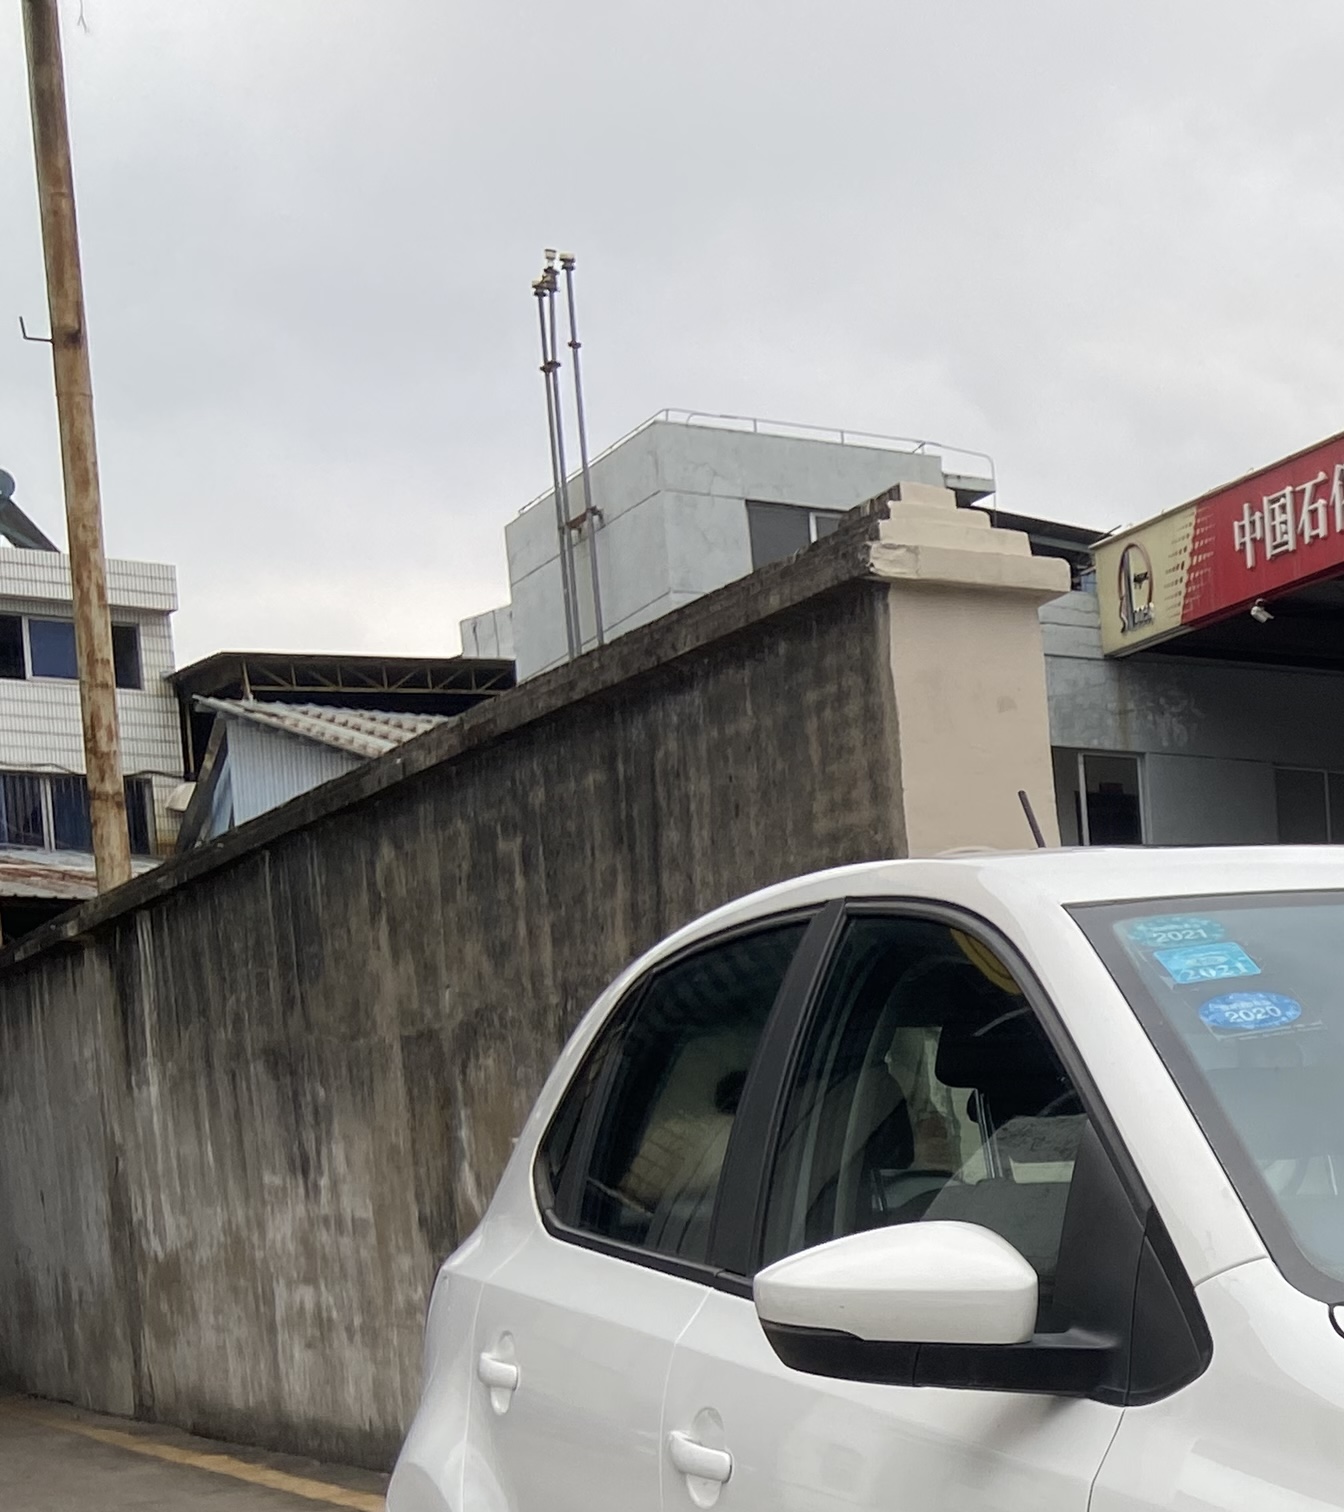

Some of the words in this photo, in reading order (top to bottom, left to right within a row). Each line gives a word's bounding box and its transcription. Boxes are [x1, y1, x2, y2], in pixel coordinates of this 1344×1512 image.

[1153, 927, 1209, 943] 2021
[1180, 962, 1249, 982] 2021
[1224, 1005, 1283, 1024] 2020
